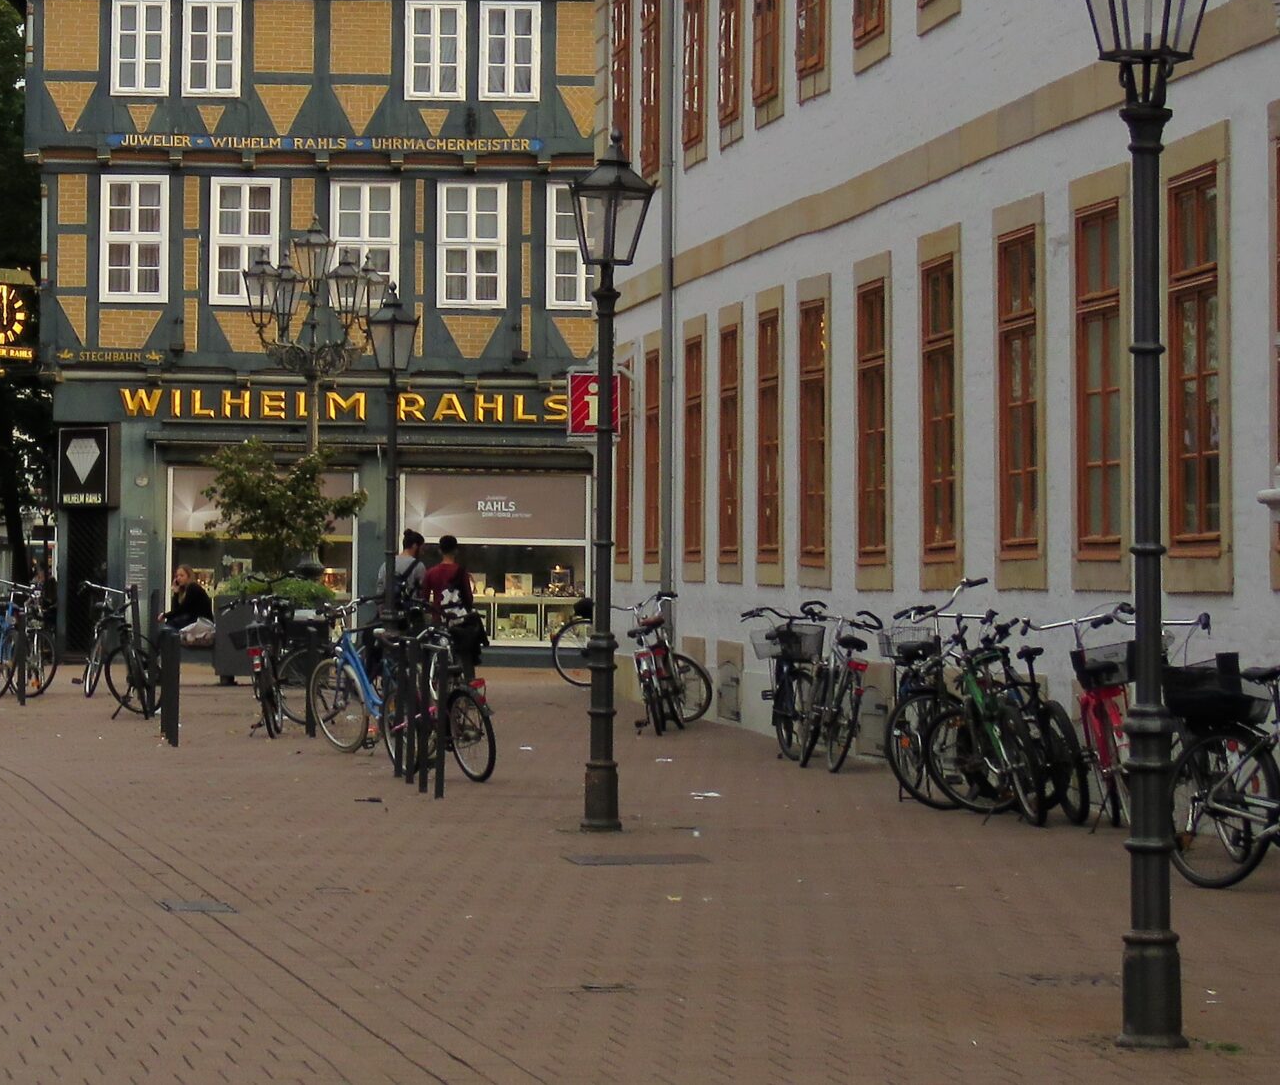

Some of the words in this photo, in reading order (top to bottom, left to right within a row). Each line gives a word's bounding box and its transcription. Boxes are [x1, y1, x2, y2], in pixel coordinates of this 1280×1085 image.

[121, 134, 191, 147] JUWELIER
[210, 136, 281, 149] WILHELM
[293, 137, 347, 150] RAHLS
[371, 138, 531, 151] UHRMACHERMEISTER
[9, 349, 33, 358] RAHLS
[79, 351, 141, 362] STECHBAHN
[120, 387, 367, 421] WILHELM
[396, 392, 568, 422] RAHLS
[63, 493, 85, 504] WILHELM
[85, 493, 102, 504] RAHLS
[477, 500, 516, 512] RAHLS
